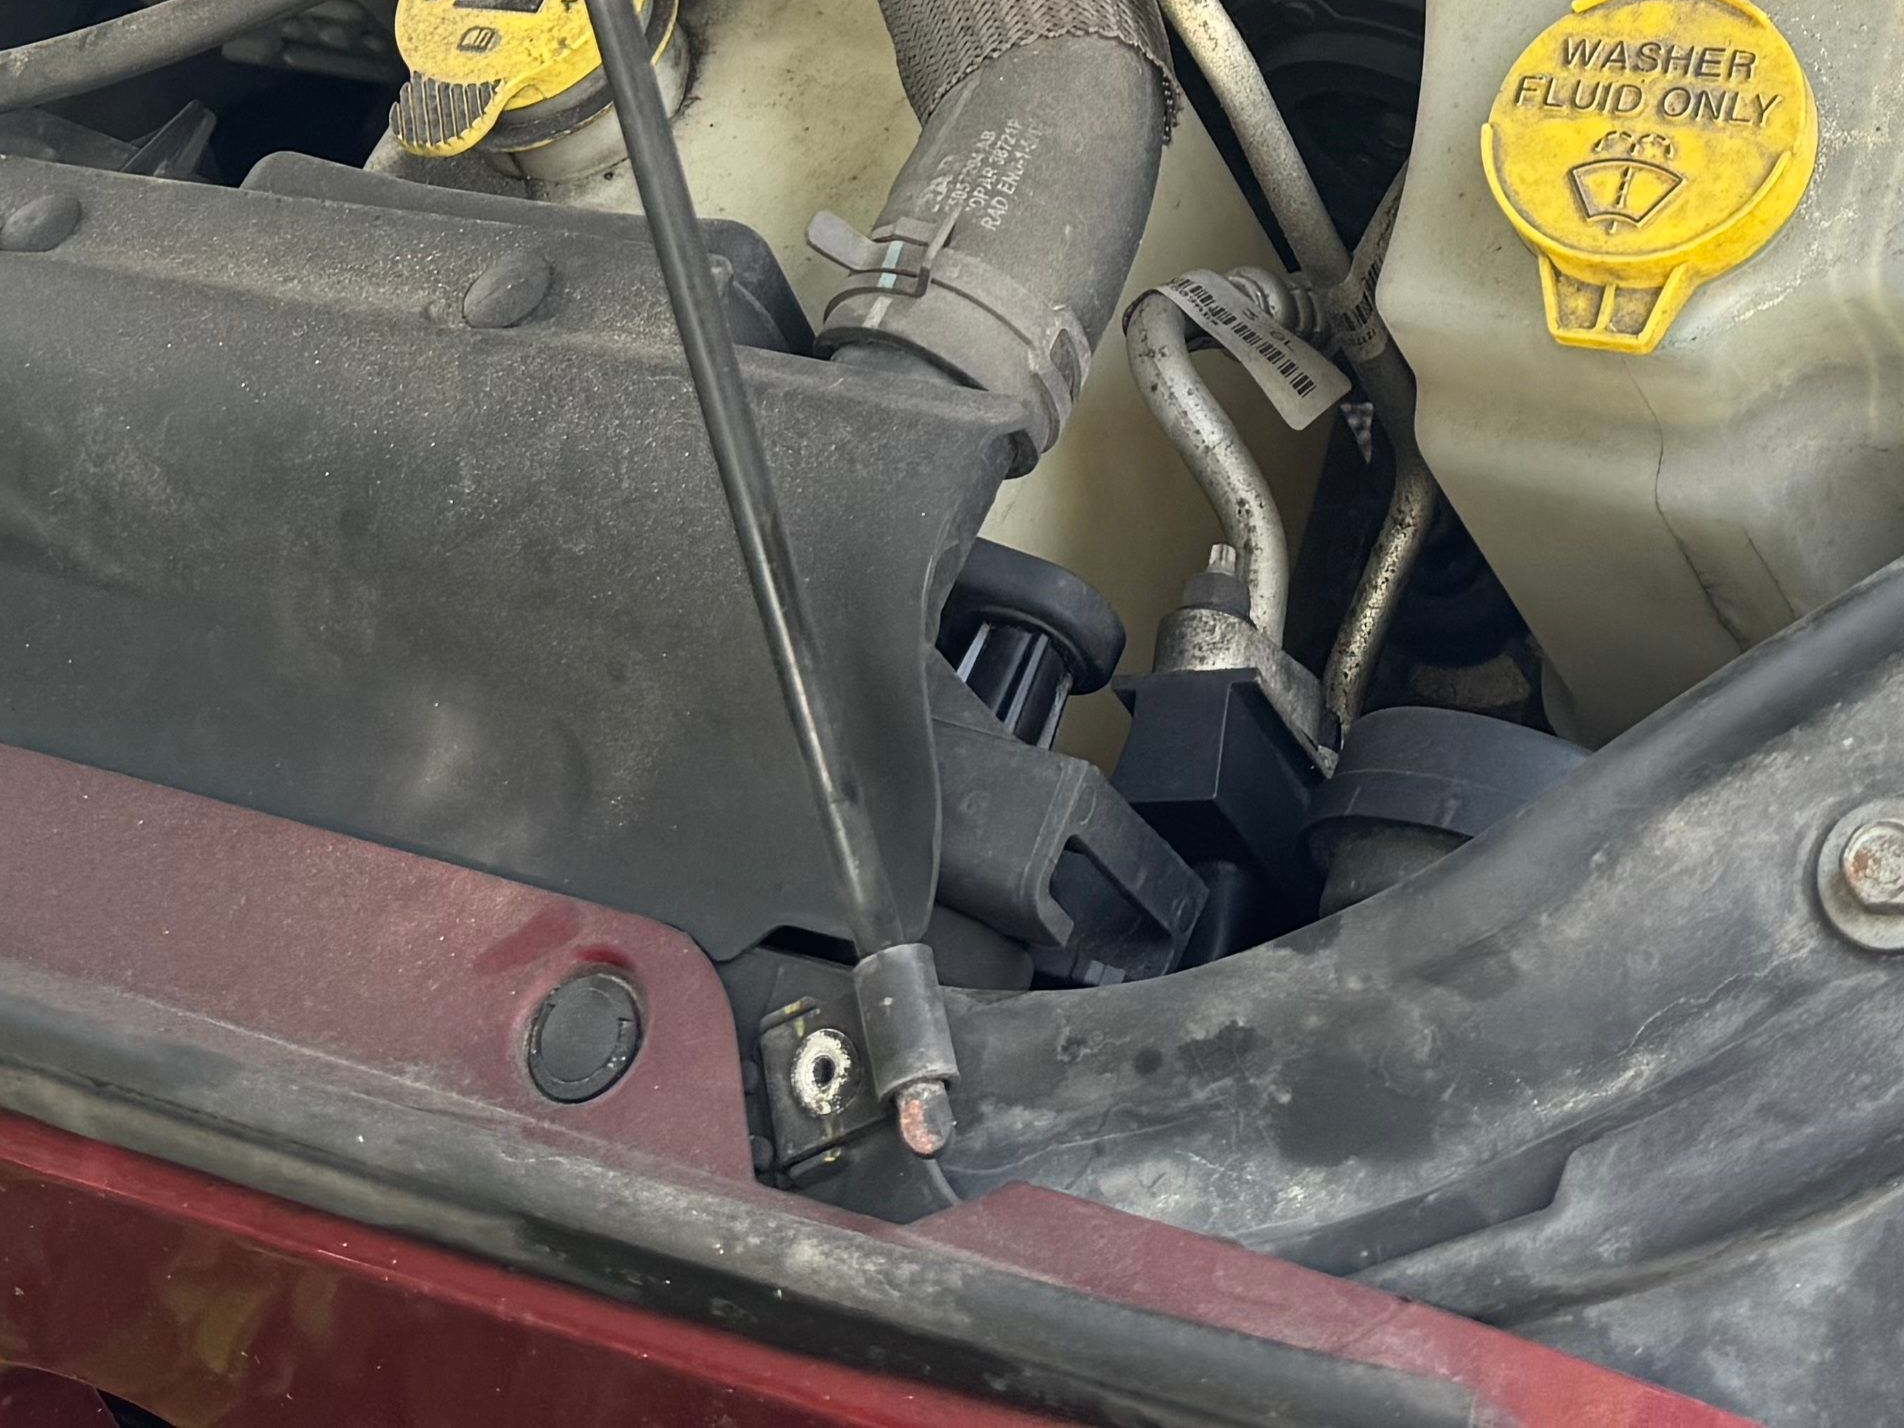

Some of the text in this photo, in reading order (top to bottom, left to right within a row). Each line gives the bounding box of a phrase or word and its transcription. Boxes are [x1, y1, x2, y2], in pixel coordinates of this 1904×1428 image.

[1560, 34, 1758, 82] WASHER
[1511, 75, 1783, 130] FLUID ONLY
[966, 165, 999, 214] OPAR
[980, 194, 1009, 232] RAD
